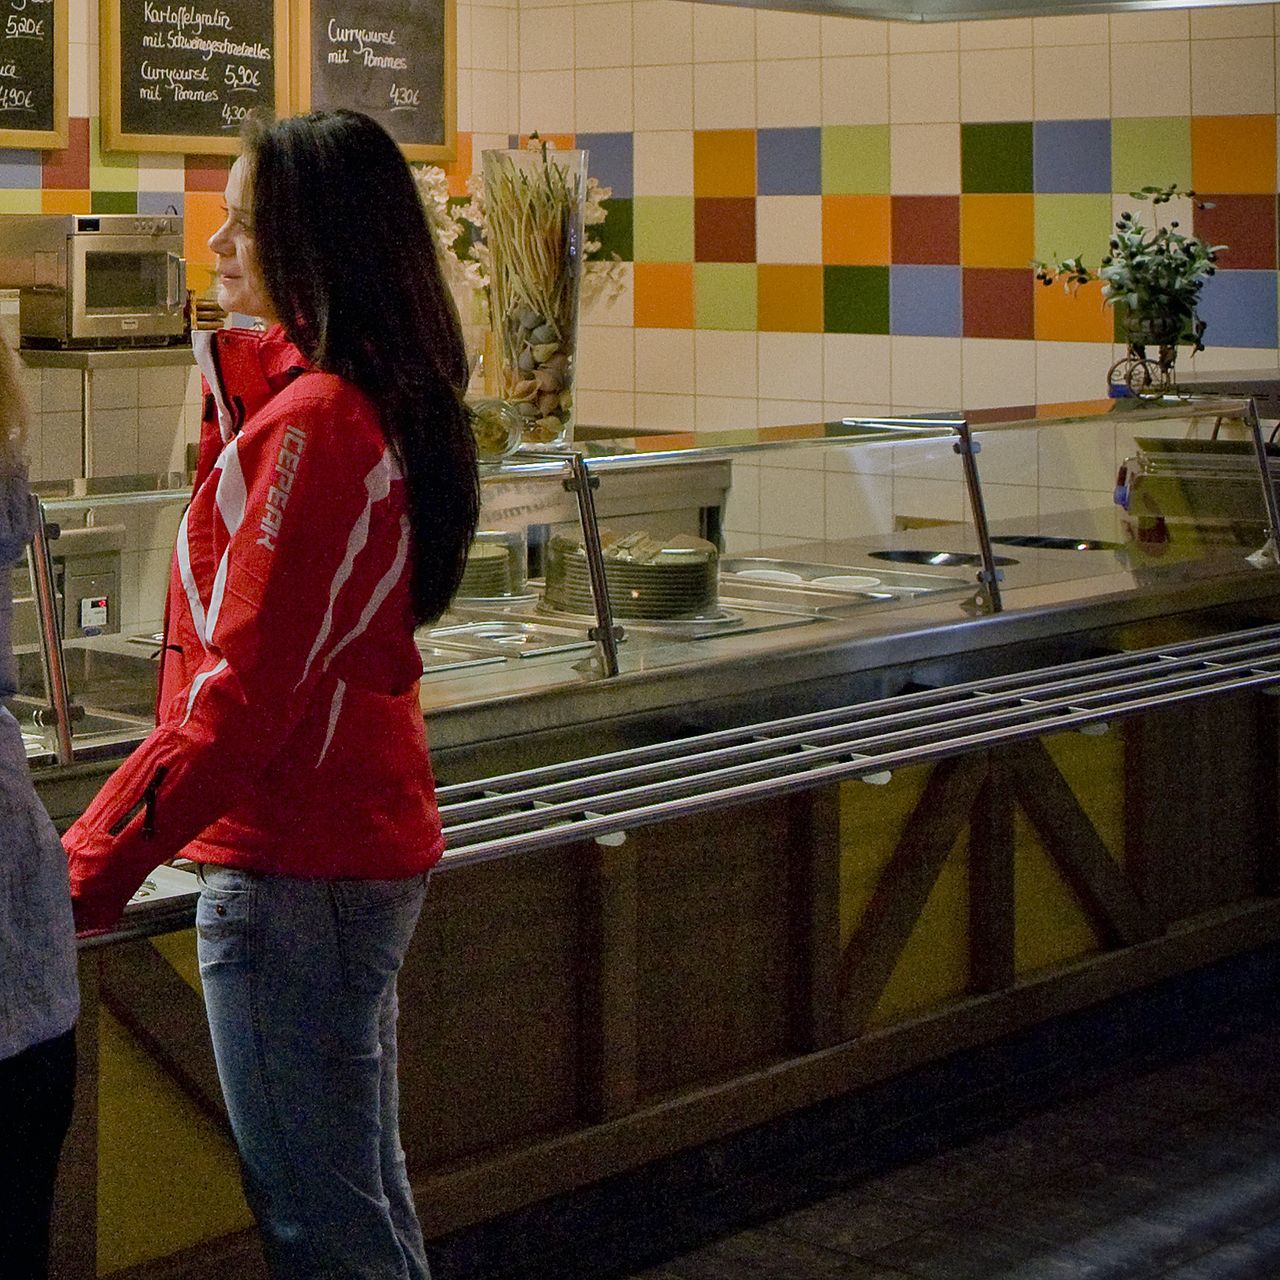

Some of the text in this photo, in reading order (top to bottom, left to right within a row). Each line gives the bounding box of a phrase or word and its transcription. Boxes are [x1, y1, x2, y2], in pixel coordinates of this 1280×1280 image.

[6, 15, 44, 37] 5,20€
[144, 0, 233, 35] Kartoffelgratin
[142, 32, 165, 48] mit
[328, 19, 396, 54] Currywurst
[327, 47, 407, 70] mit Pommes
[141, 60, 209, 89] Currywurst
[140, 83, 218, 101] mit Pommes
[256, 425, 306, 551] ICEPEAK
